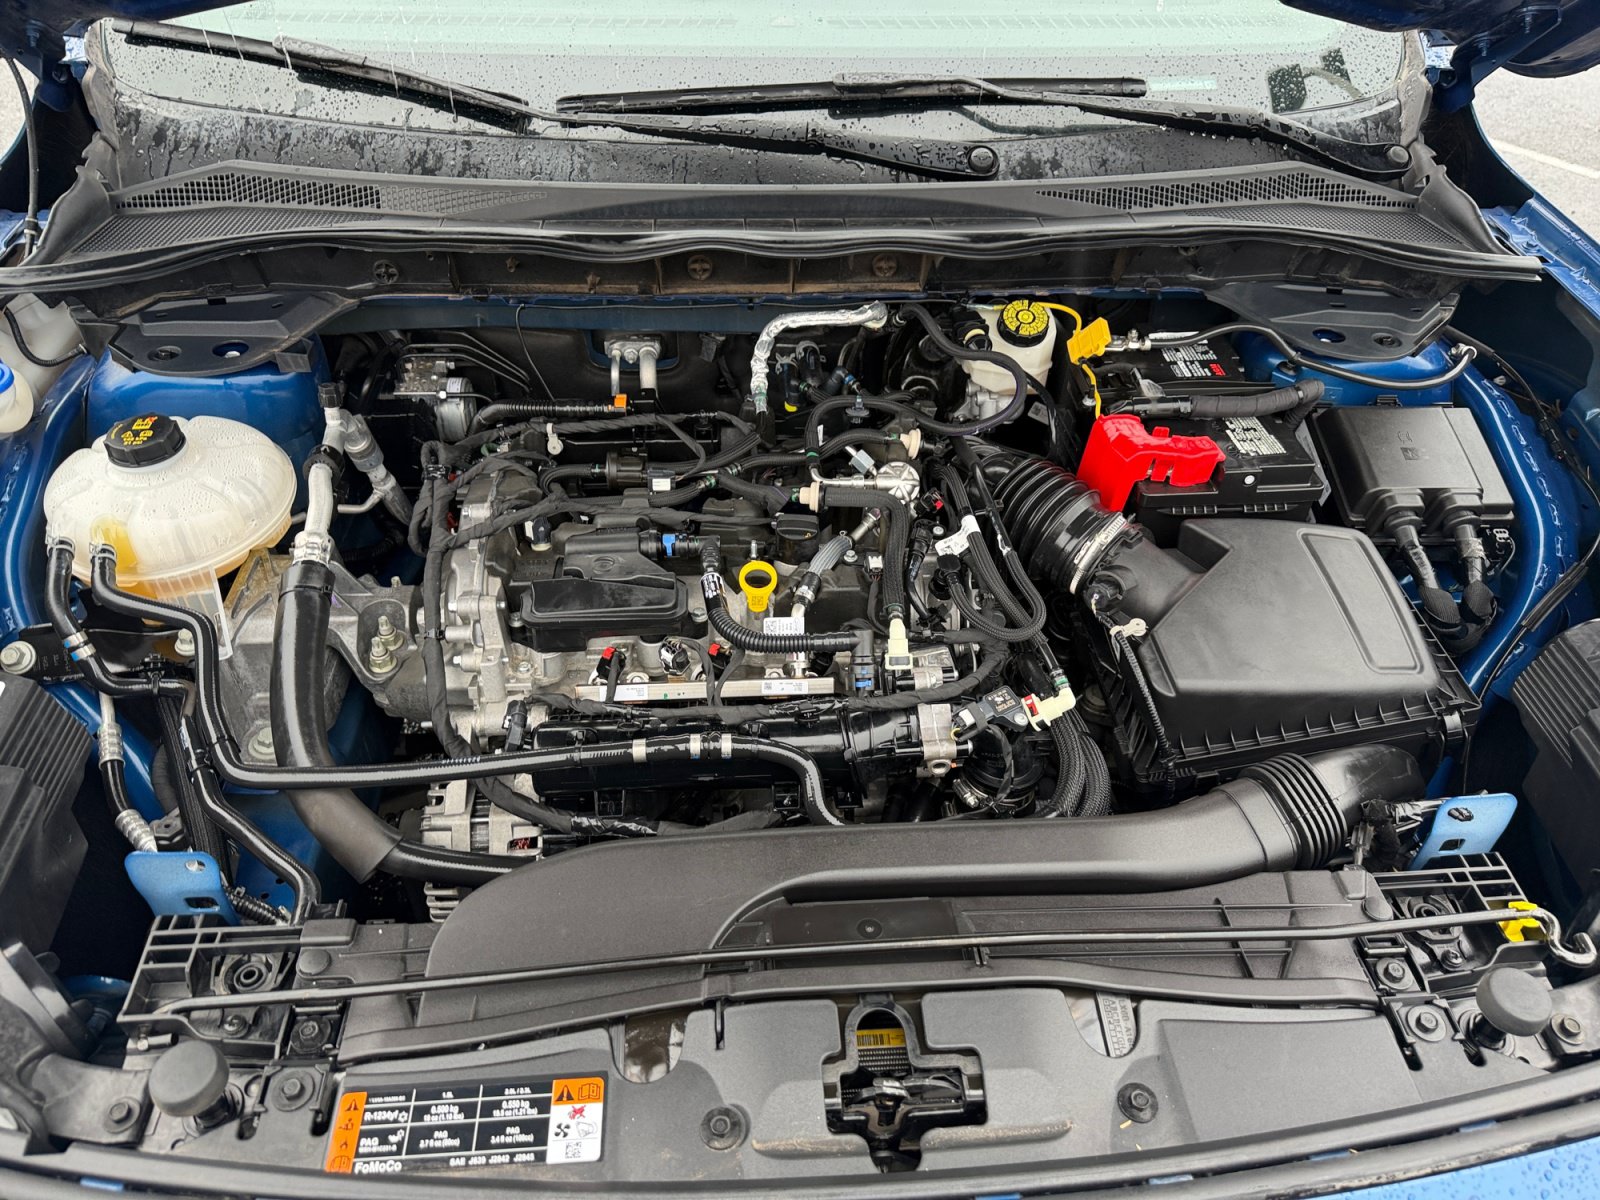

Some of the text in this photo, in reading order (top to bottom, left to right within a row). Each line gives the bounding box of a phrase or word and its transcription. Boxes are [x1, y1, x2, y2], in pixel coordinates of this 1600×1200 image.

[449, 1103, 459, 1114] kg
[520, 1099, 530, 1109] kg
[364, 1110, 399, 1121] R-1234yf
[433, 1130, 449, 1139] PAG
[506, 1126, 520, 1135] PAG
[360, 1137, 379, 1147] PAG
[354, 1160, 402, 1174] FoMoCo
